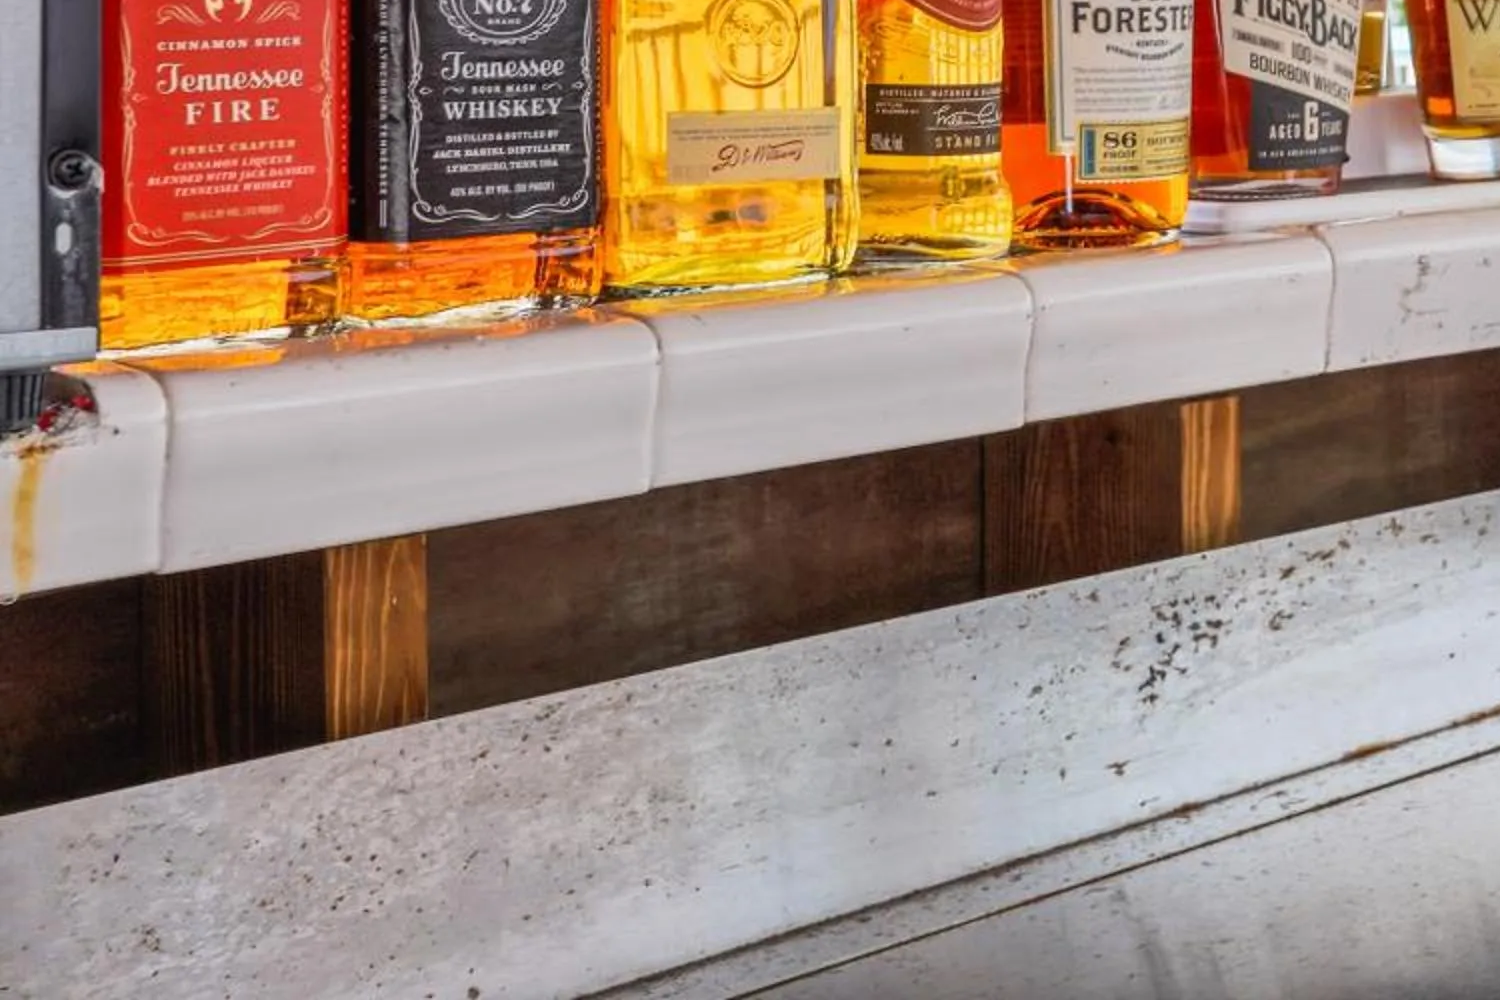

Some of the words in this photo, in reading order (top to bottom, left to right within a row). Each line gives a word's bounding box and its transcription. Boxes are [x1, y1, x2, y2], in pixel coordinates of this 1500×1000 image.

[156, 38, 248, 51] CINNAMON
[254, 35, 302, 48] SPICE
[156, 63, 304, 95] Tennessee
[441, 51, 565, 81] Tennessee
[1249, 51, 1311, 87] BOURBON
[185, 98, 281, 126] FIRE
[442, 97, 563, 121] WHISKEY
[1269, 123, 1300, 139] AGED
[1304, 101, 1319, 141] 6
[935, 134, 981, 149] STAND
[1103, 131, 1137, 149] 86
